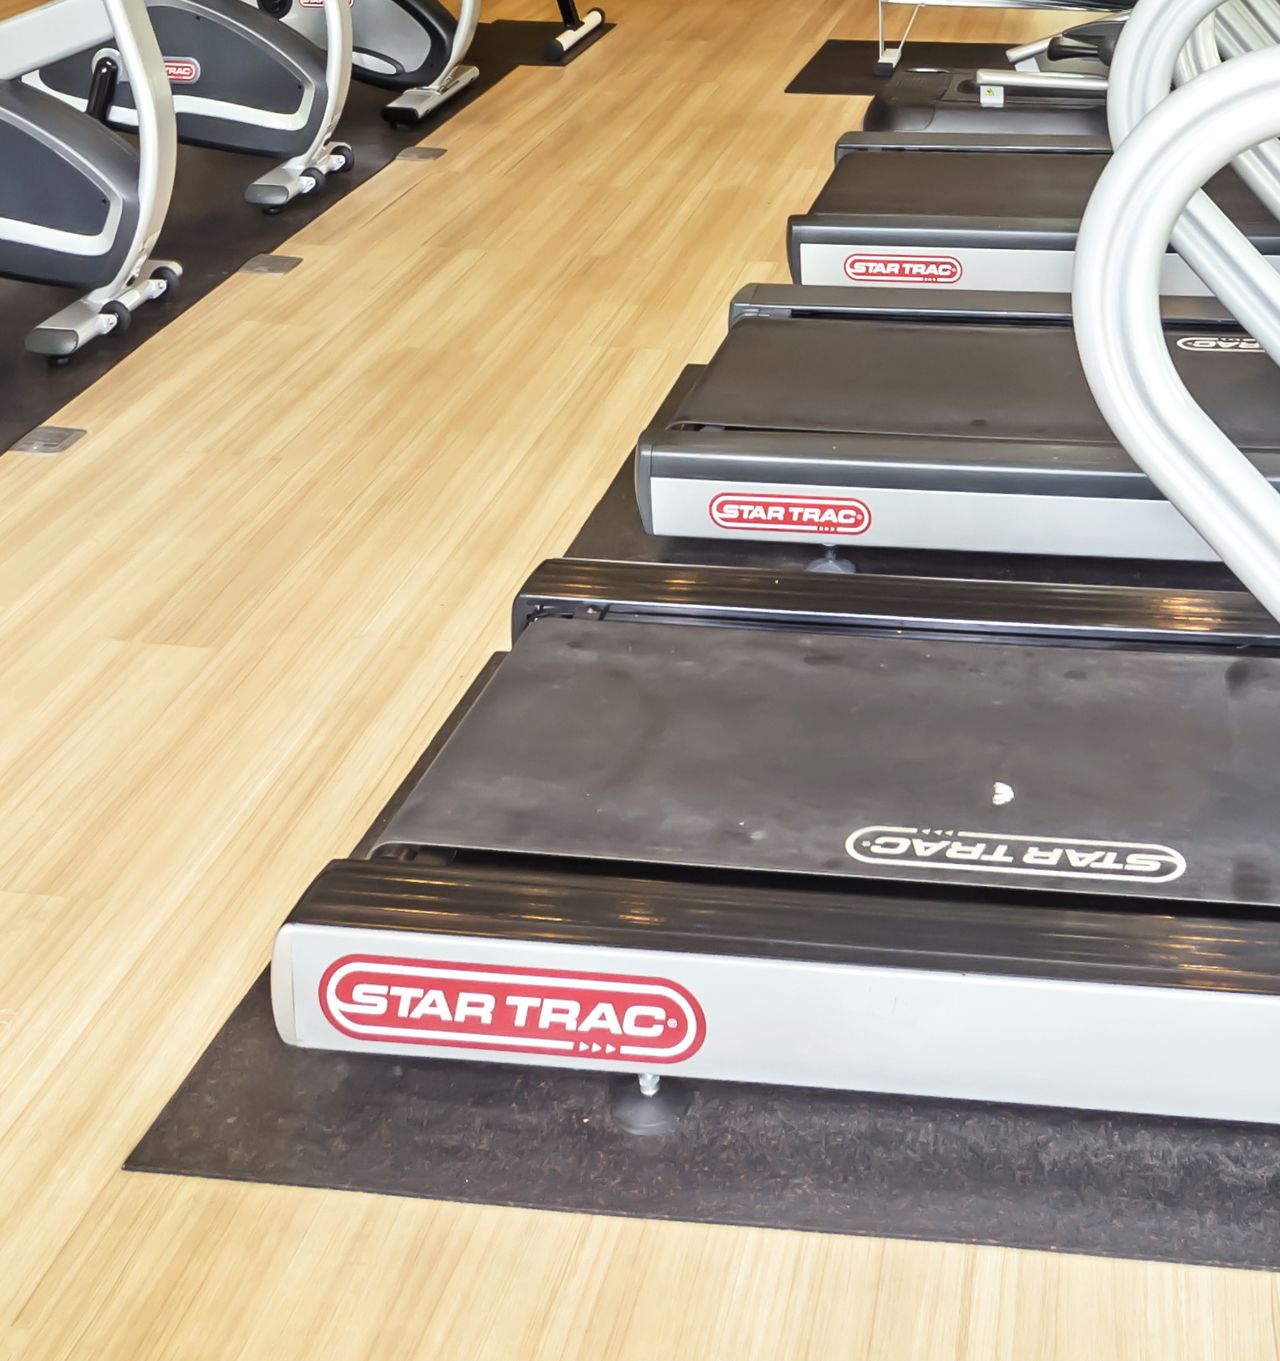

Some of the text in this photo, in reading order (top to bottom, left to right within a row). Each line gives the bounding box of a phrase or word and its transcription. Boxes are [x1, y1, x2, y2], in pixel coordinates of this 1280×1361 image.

[853, 262, 952, 276] STAR TRAC
[1193, 339, 1260, 348] RAC
[722, 504, 857, 524] STAR TRAC
[870, 836, 1163, 871] STAR TRAC
[351, 984, 667, 1037] STAR TRAC
